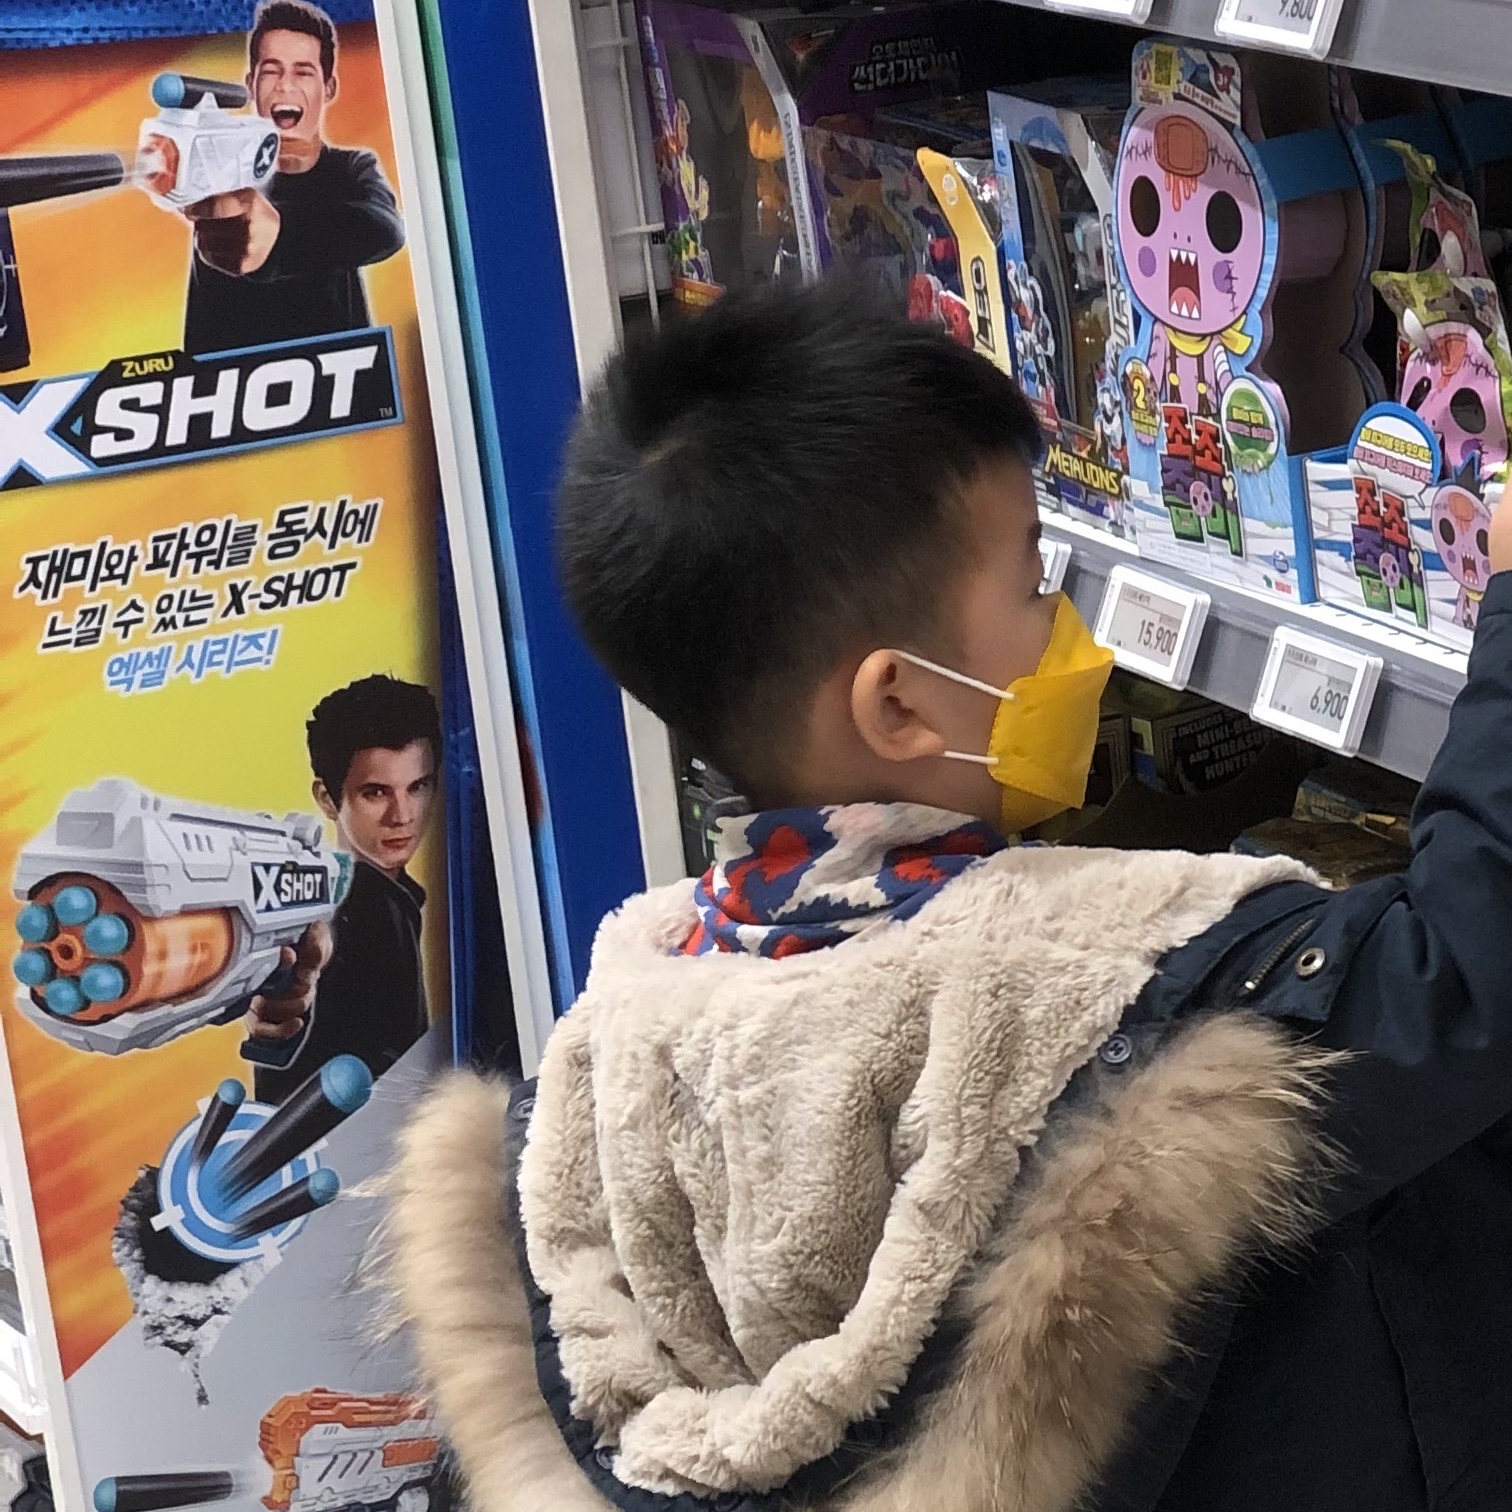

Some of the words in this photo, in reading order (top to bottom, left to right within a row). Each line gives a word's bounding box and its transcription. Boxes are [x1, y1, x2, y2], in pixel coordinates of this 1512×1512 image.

[121, 352, 175, 378] ZURU
[90, 346, 378, 459] SHOT
[1044, 443, 1122, 497] METALIONS
[18, 543, 137, 602] 재미와
[147, 516, 257, 581] 파워를
[265, 501, 378, 561] 동시에
[41, 611, 100, 649] 느낄
[113, 601, 144, 633] 수
[153, 585, 214, 631] 있는
[221, 563, 356, 619] X-SHOT
[106, 644, 173, 692] 엑셀
[176, 629, 278, 679] 시리즈!
[1138, 619, 1178, 655] 15.900
[1310, 686, 1349, 721] 6.900
[280, 873, 323, 903] SHOT
